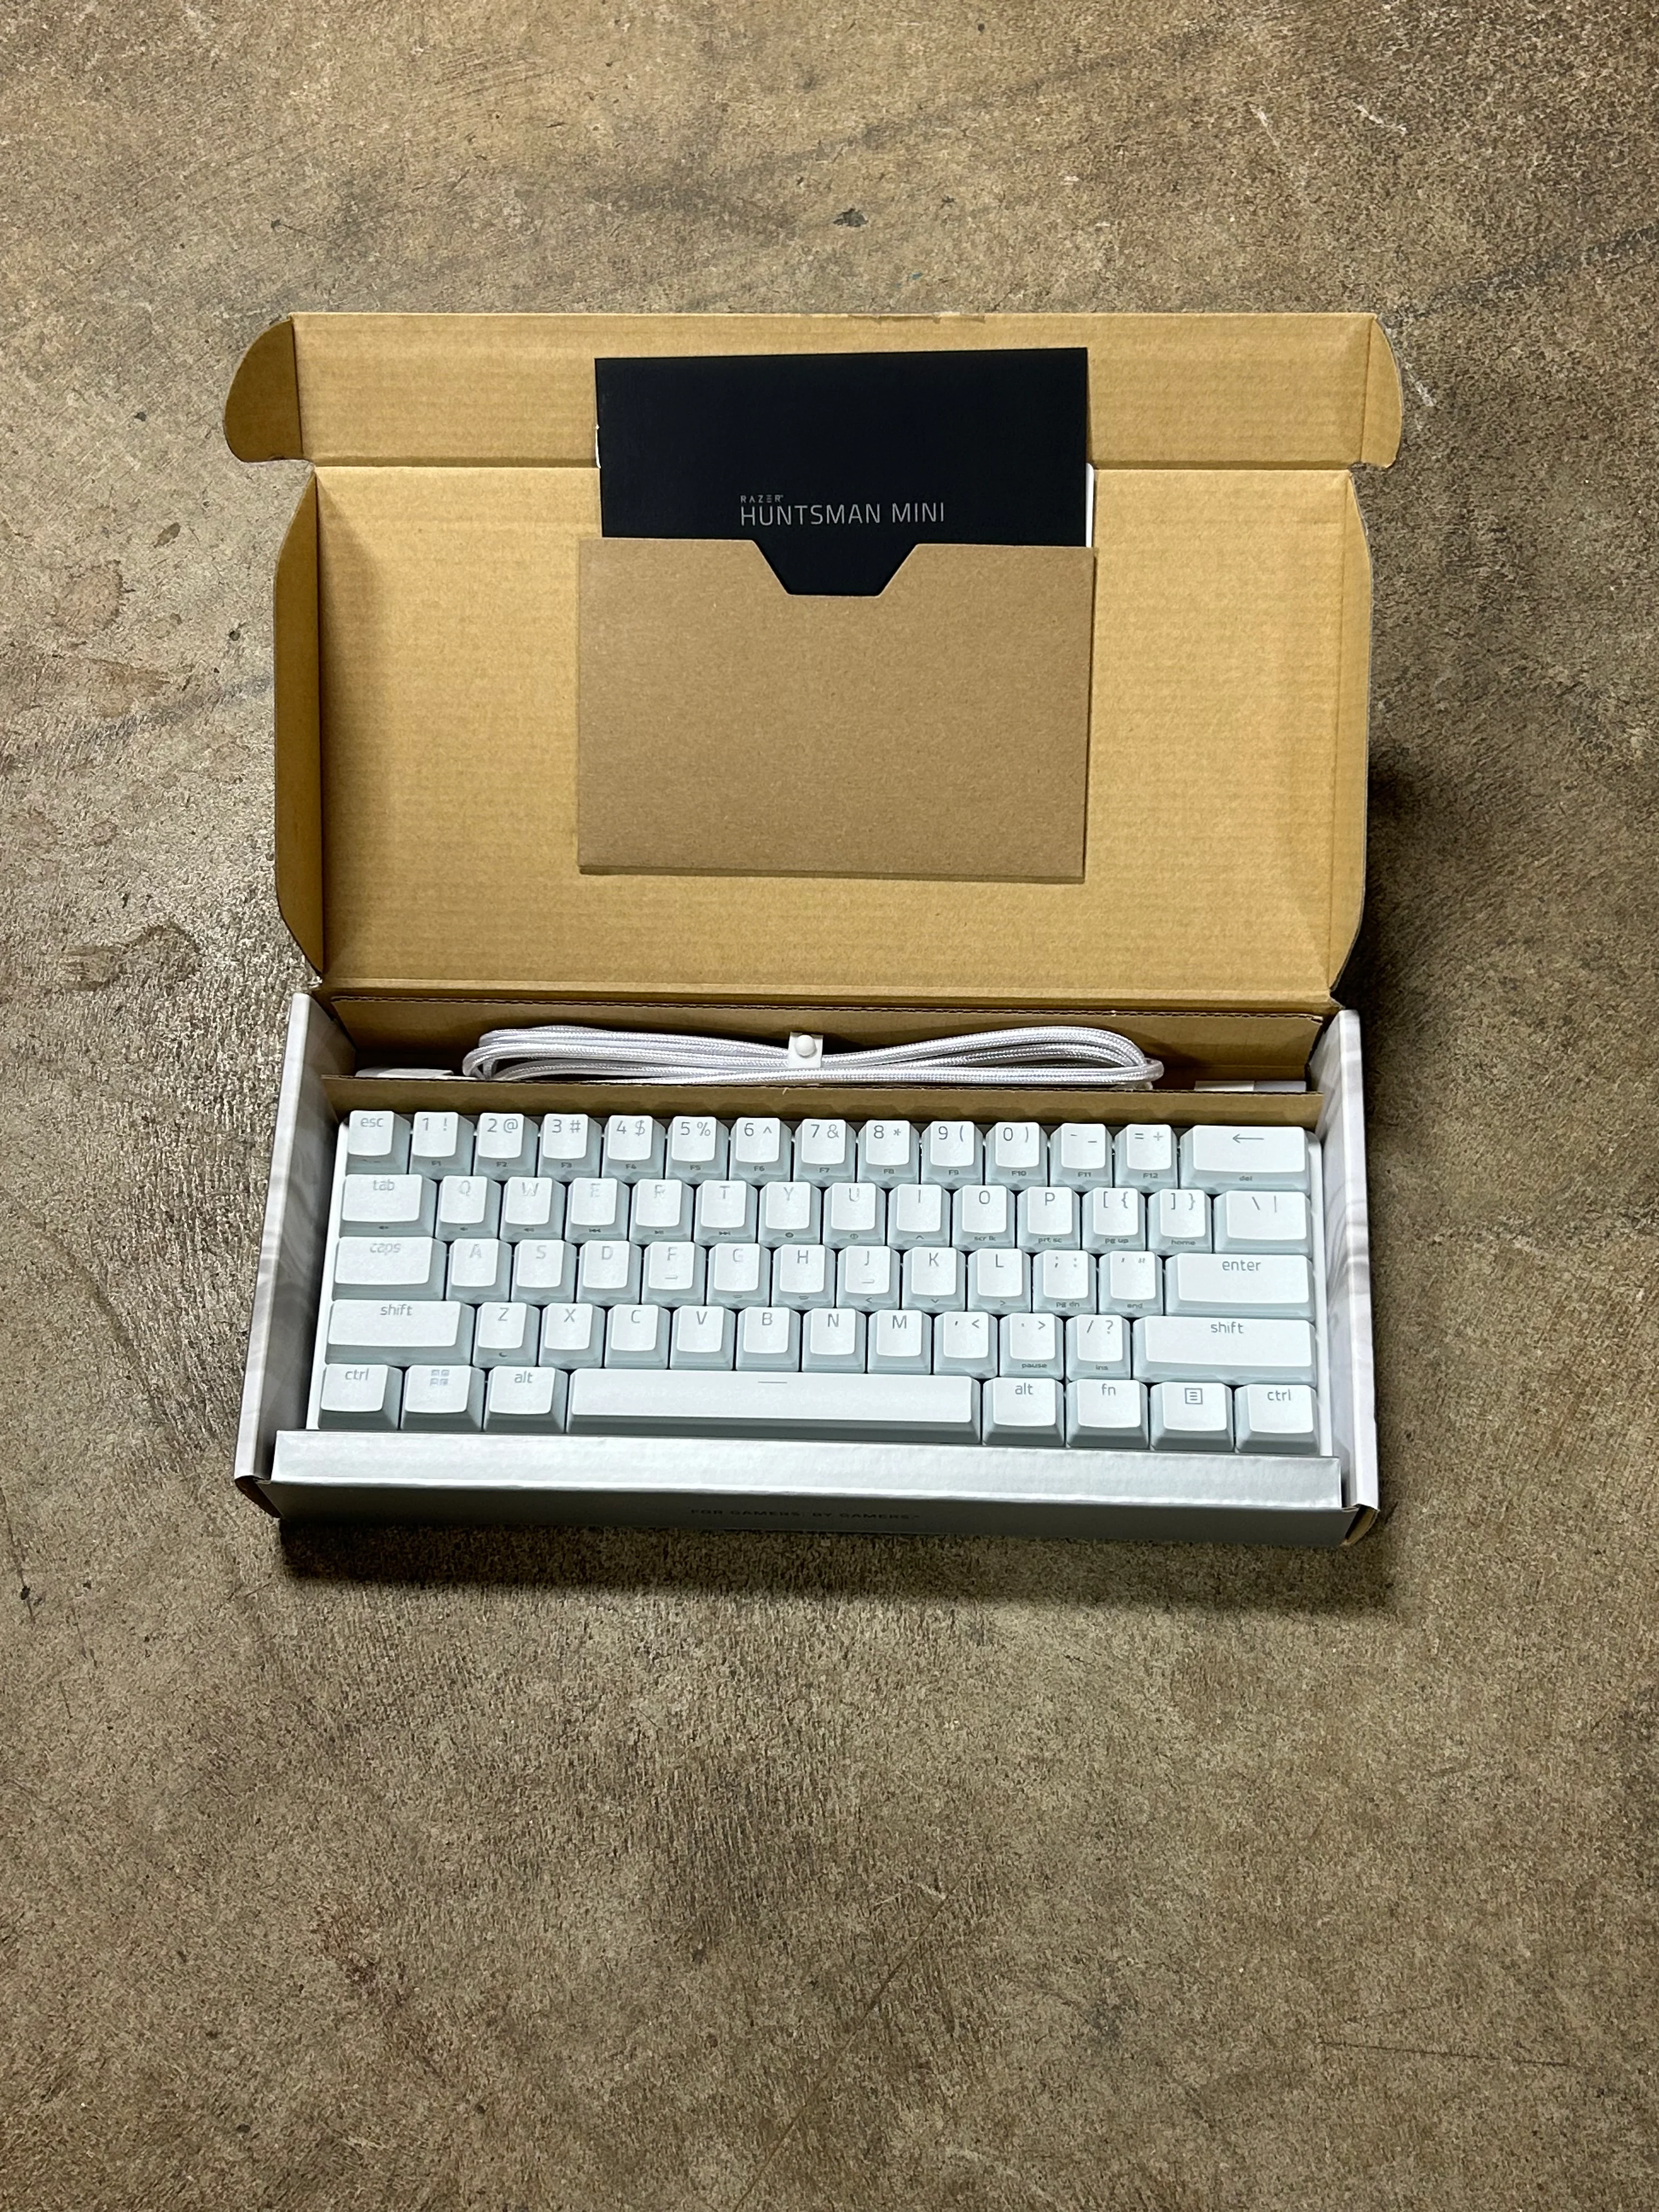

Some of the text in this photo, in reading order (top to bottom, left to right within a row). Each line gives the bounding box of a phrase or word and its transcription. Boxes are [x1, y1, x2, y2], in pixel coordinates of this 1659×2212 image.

[741, 502, 944, 526] HUNTSMAN MINI
[360, 1117, 383, 1127] esc
[373, 1180, 394, 1191] tab
[459, 1181, 471, 1197] Q
[522, 1182, 539, 1197] W
[590, 1183, 601, 1198] E
[719, 1186, 731, 1199] T
[783, 1187, 794, 1201] Y
[849, 1188, 860, 1202] U
[1045, 1192, 1055, 1206] P
[370, 1243, 401, 1256] caps
[469, 1244, 482, 1259] A
[535, 1244, 547, 1259] S
[601, 1246, 613, 1260] D
[667, 1246, 678, 1261] F
[732, 1248, 744, 1262] G
[797, 1250, 809, 1264] H
[865, 1250, 870, 1266] J
[929, 1252, 939, 1267] K
[995, 1254, 1004, 1268] L
[1222, 1260, 1261, 1272] enter
[380, 1304, 413, 1316] shift
[498, 1307, 510, 1322] Z
[563, 1308, 577, 1323] X
[631, 1310, 641, 1324] C
[696, 1311, 708, 1325] V
[762, 1312, 773, 1326] B
[827, 1313, 839, 1328] N
[892, 1315, 907, 1329] M
[1210, 1322, 1244, 1334] shift
[345, 1368, 369, 1381] ctrl
[514, 1372, 533, 1384] alt
[1015, 1383, 1034, 1396] alt
[1102, 1384, 1116, 1396] fn
[1267, 1389, 1291, 1402] ctrl
